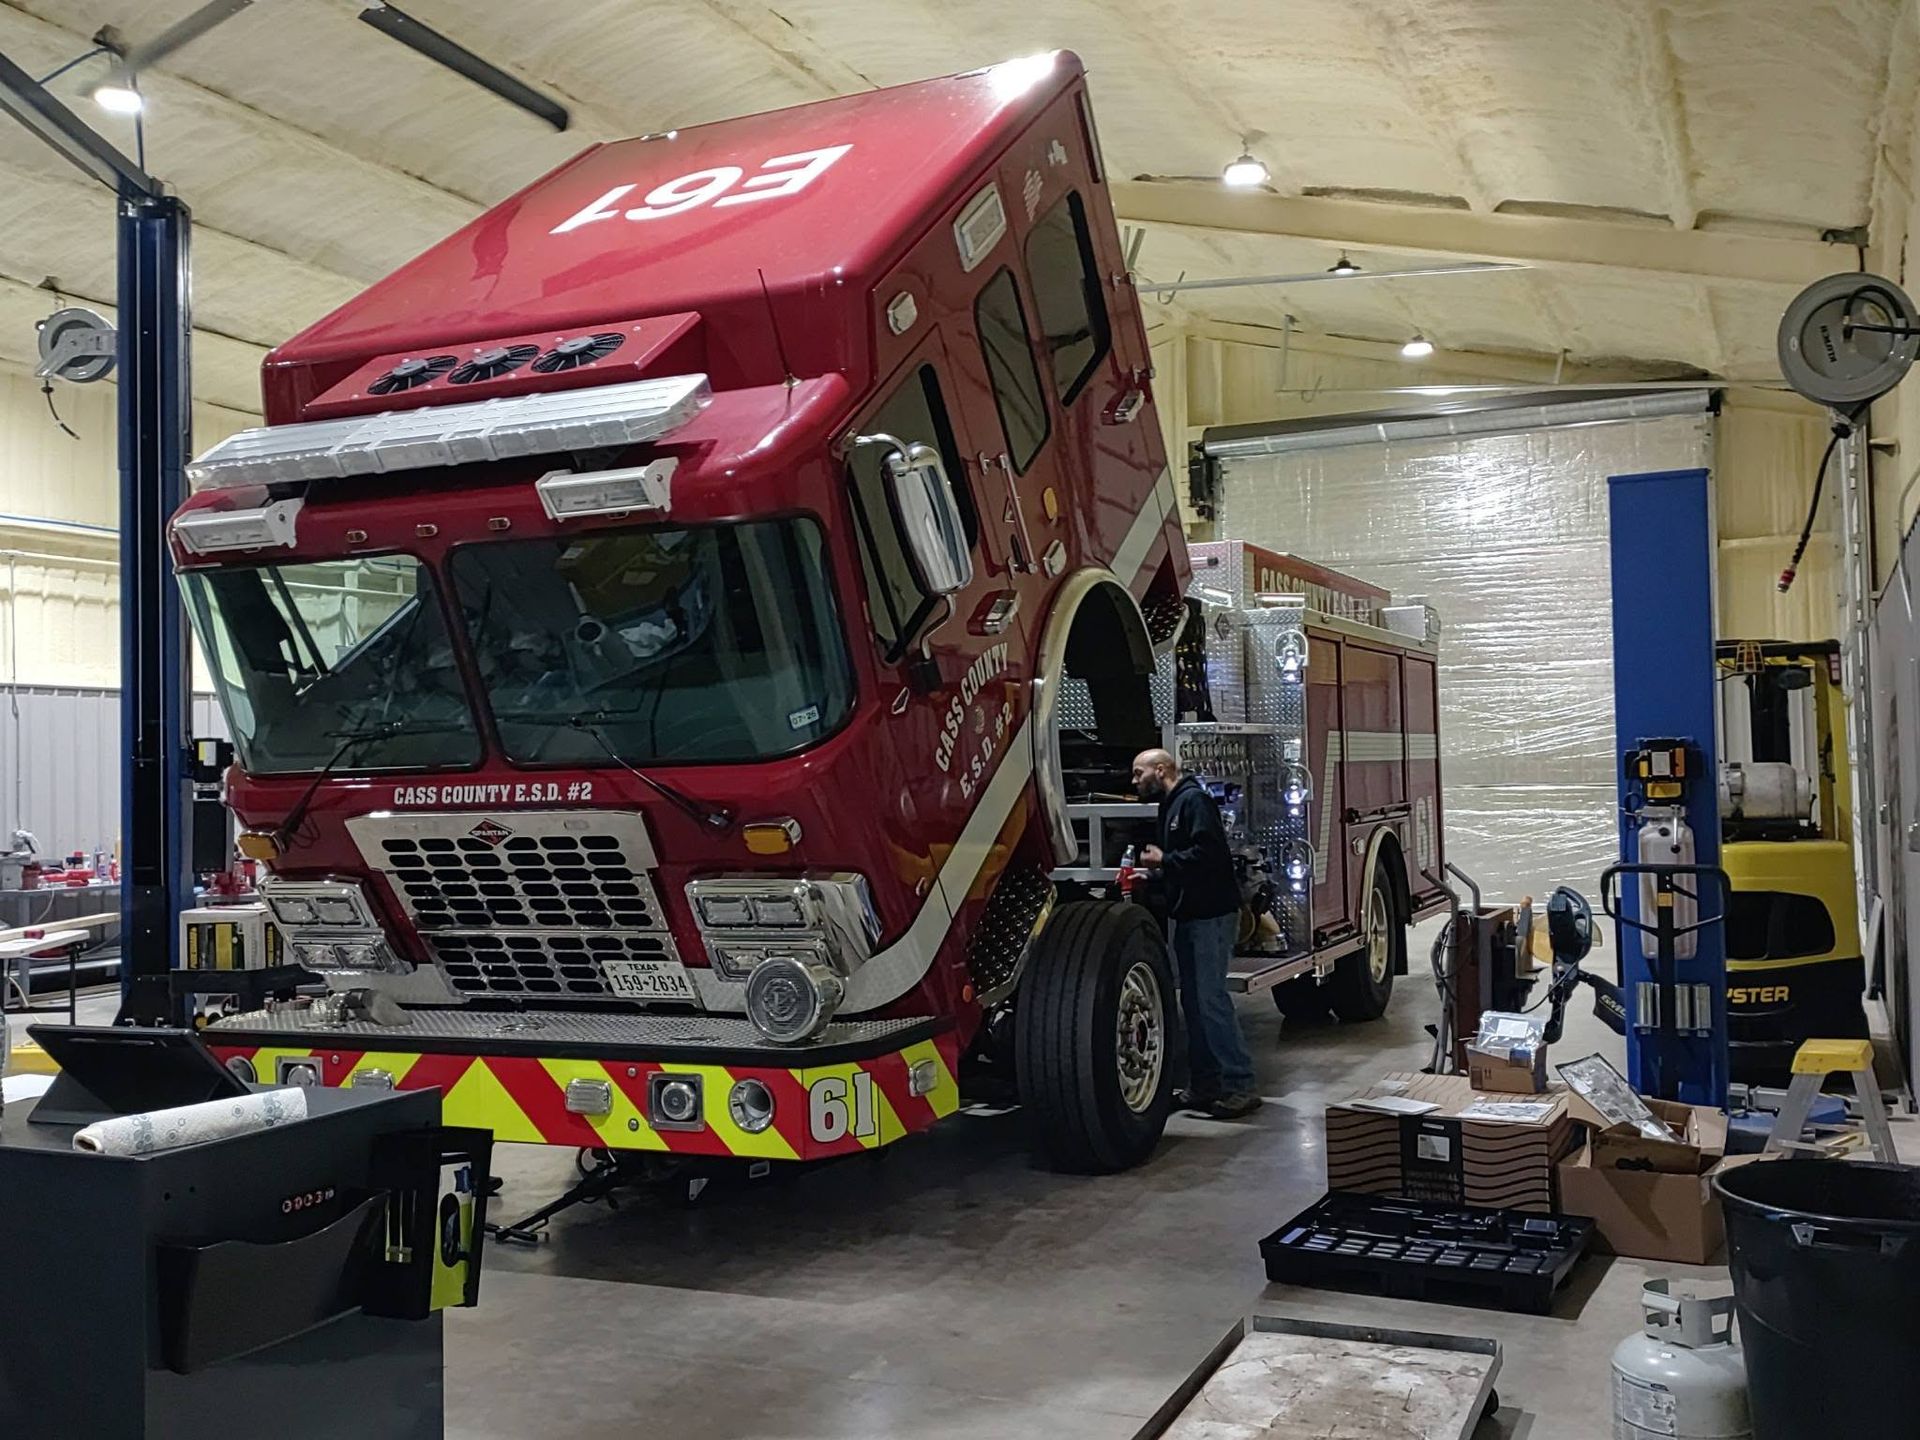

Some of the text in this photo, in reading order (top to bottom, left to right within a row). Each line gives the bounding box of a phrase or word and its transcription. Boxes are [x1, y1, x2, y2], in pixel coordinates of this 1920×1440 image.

[549, 144, 854, 234] E61
[935, 642, 1008, 772] CASS COUNTY
[959, 702, 1013, 799] E.S.D. #2
[394, 782, 592, 804] CASS COUNTY E.S.D. #2
[627, 963, 659, 971] TEXAS
[1727, 986, 1790, 1004] STER
[808, 1071, 876, 1143] 61
